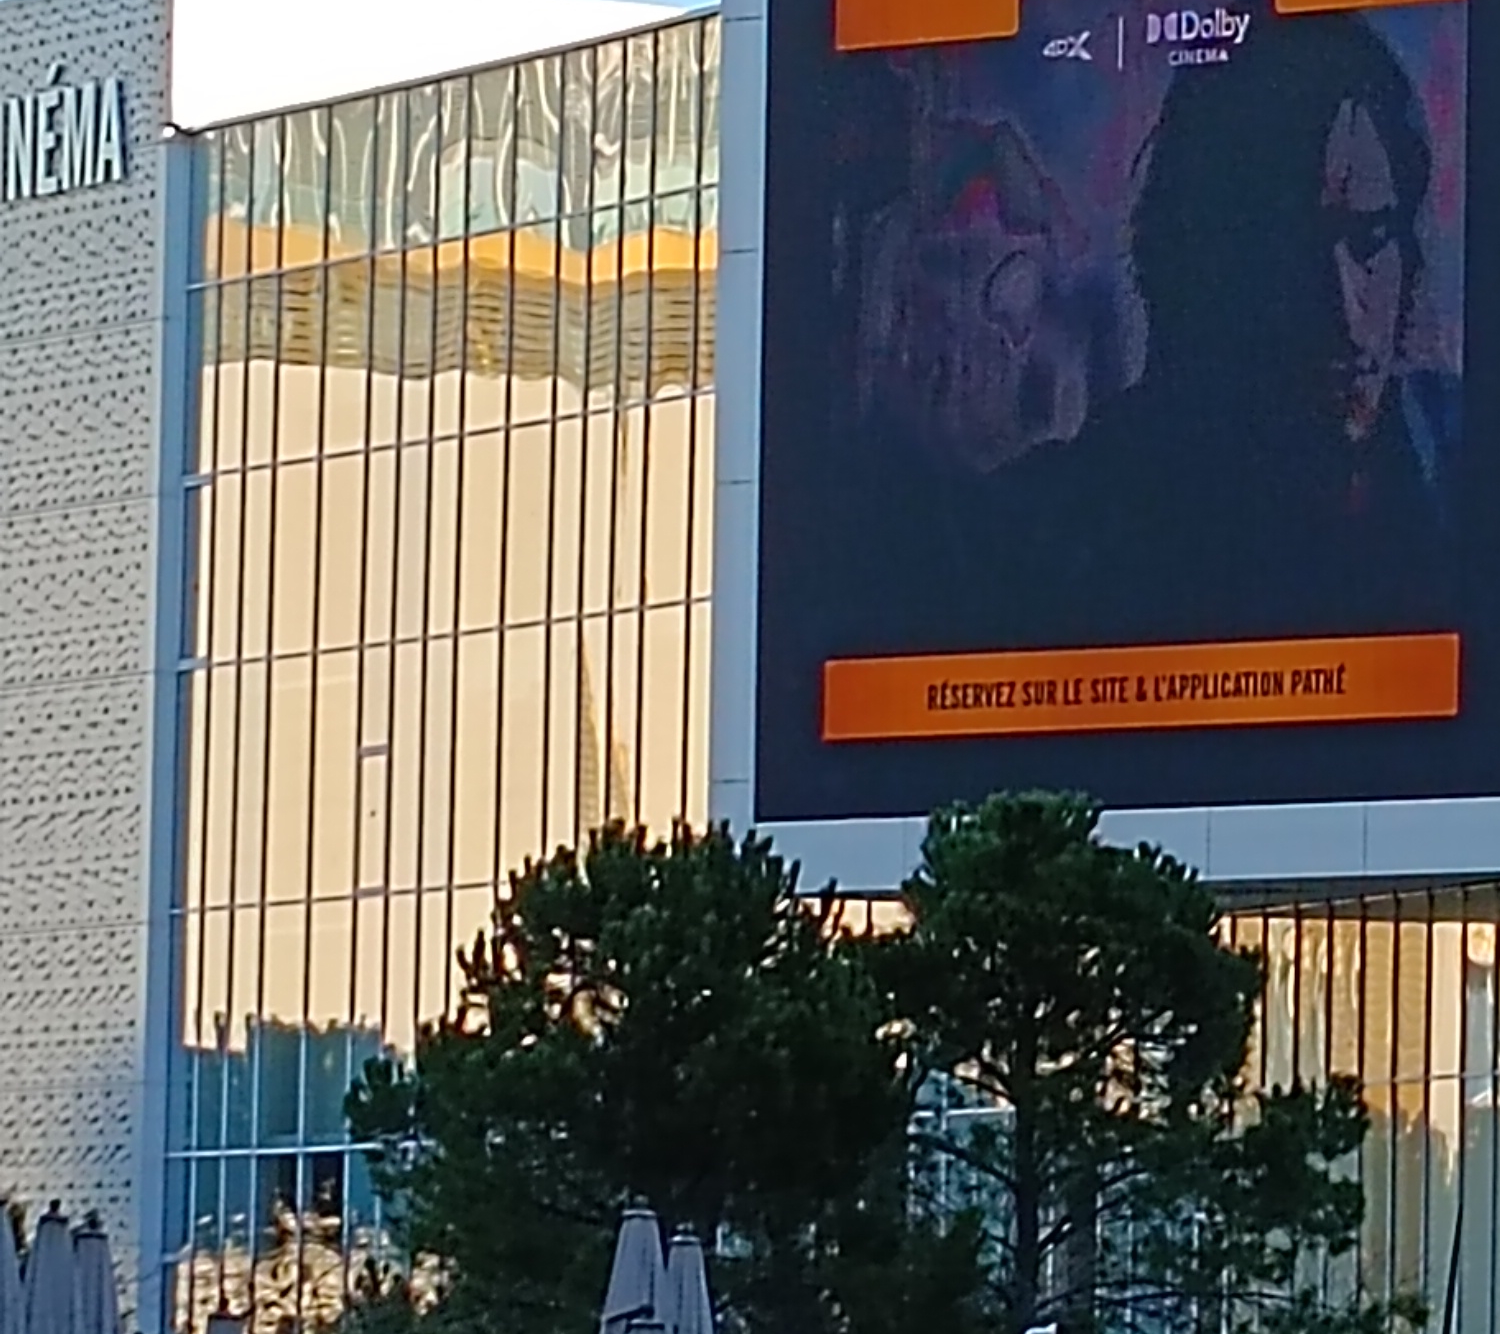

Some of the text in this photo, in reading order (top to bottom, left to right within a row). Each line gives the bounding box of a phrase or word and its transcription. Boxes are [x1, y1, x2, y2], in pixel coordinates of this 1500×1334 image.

[1180, 7, 1251, 44] Dolby
[1168, 48, 1229, 66] CINEMA
[0, 61, 122, 200] NÉMA
[927, 662, 1345, 711] RÉSERVEZ SUR LE SITE & L'APPLICATION PATHÉ
